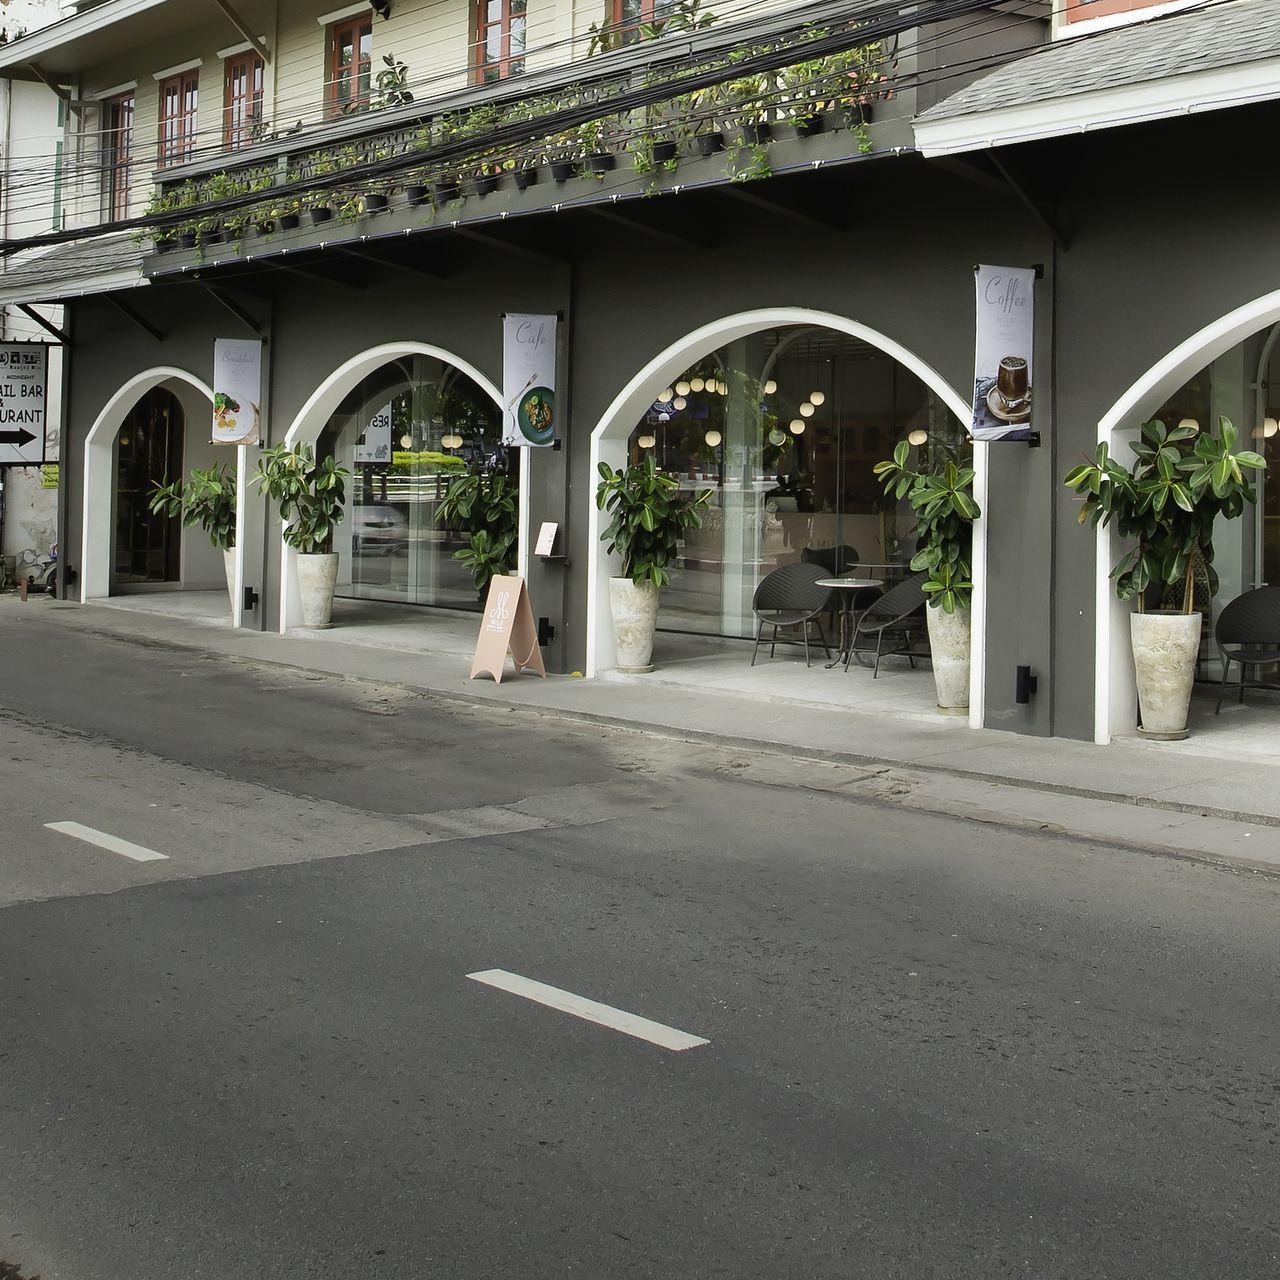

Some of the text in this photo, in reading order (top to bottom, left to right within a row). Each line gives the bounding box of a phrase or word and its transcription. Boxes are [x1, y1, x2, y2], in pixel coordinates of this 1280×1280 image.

[984, 275, 1026, 313] Coffee
[515, 320, 546, 351] Cafe
[21, 384, 43, 397] BAR
